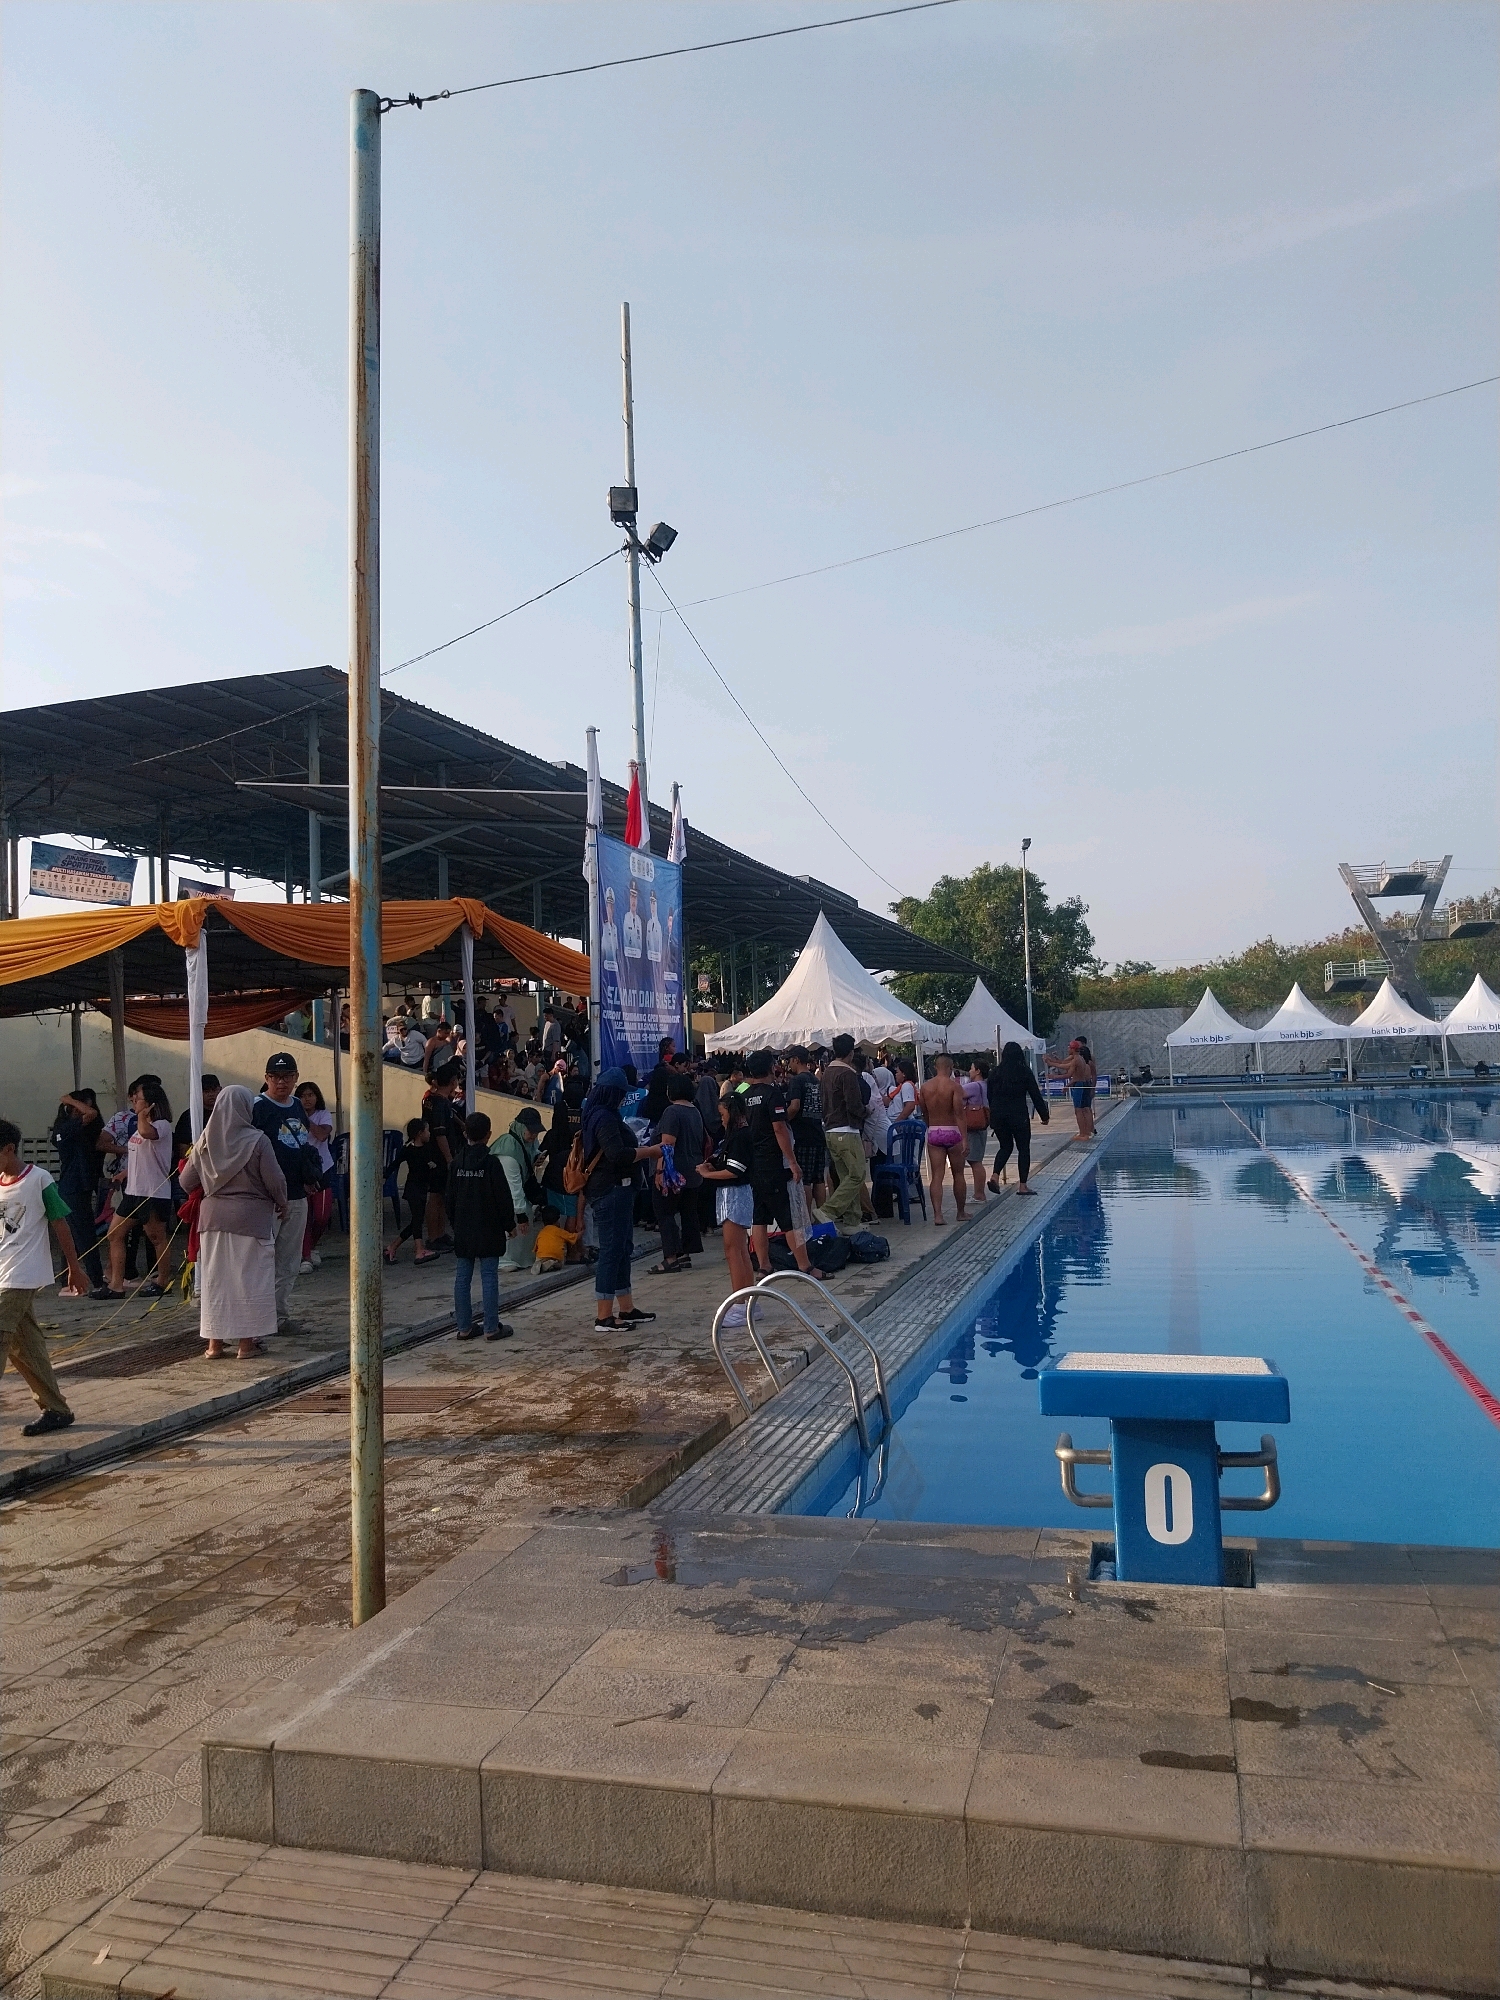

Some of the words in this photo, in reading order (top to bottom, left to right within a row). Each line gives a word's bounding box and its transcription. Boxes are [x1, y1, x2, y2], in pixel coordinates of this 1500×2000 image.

[60, 859, 107, 873] SPORTIFITAS
[638, 991, 654, 1008] DAN
[1371, 1027, 1391, 1035] bank
[1392, 1026, 1407, 1035] bjb
[1466, 1023, 1488, 1031] bank
[1189, 1036, 1209, 1044] bank
[1209, 1034, 1224, 1044] bjb
[1280, 1031, 1299, 1040] bank
[1300, 1030, 1315, 1039] bjb
[1145, 1463, 1194, 1545] 0
